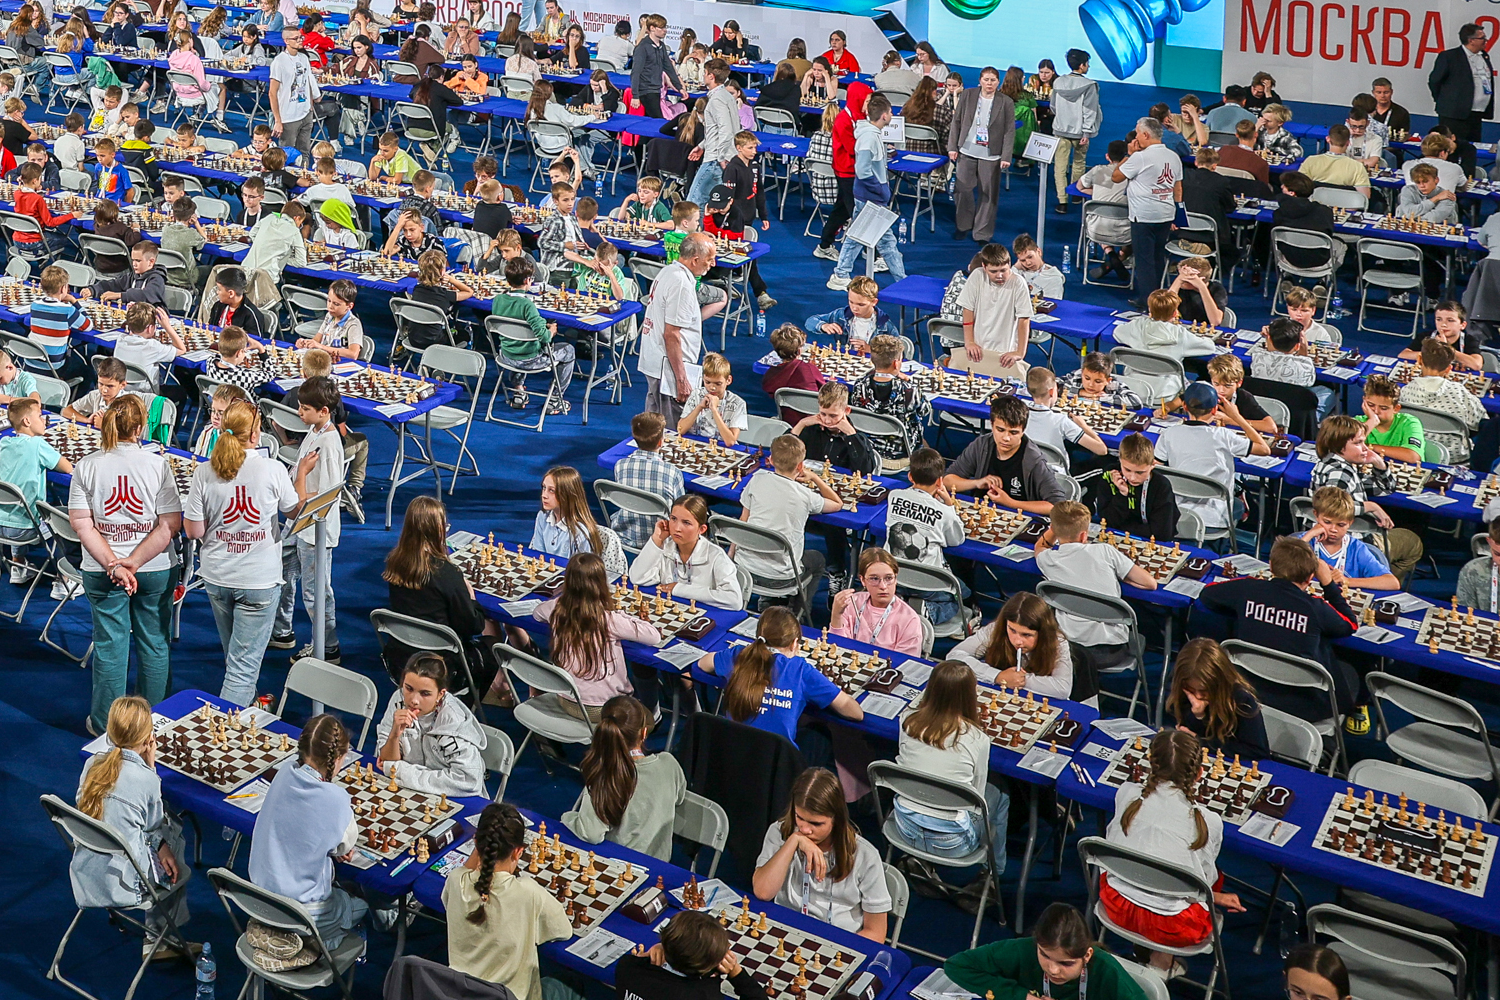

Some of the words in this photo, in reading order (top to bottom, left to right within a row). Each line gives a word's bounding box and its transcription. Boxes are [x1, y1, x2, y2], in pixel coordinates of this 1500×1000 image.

[583, 22, 605, 33] СПОРТ
[1033, 139, 1053, 150] Турнир
[891, 496, 943, 520] LEGENDS
[891, 505, 937, 527] REMAIN
[112, 531, 138, 542] СПОРТ
[215, 529, 267, 542] МОСКОВСКИЙ
[226, 542, 252, 554] СПОРТ
[1244, 600, 1309, 633] РОССИЯ
